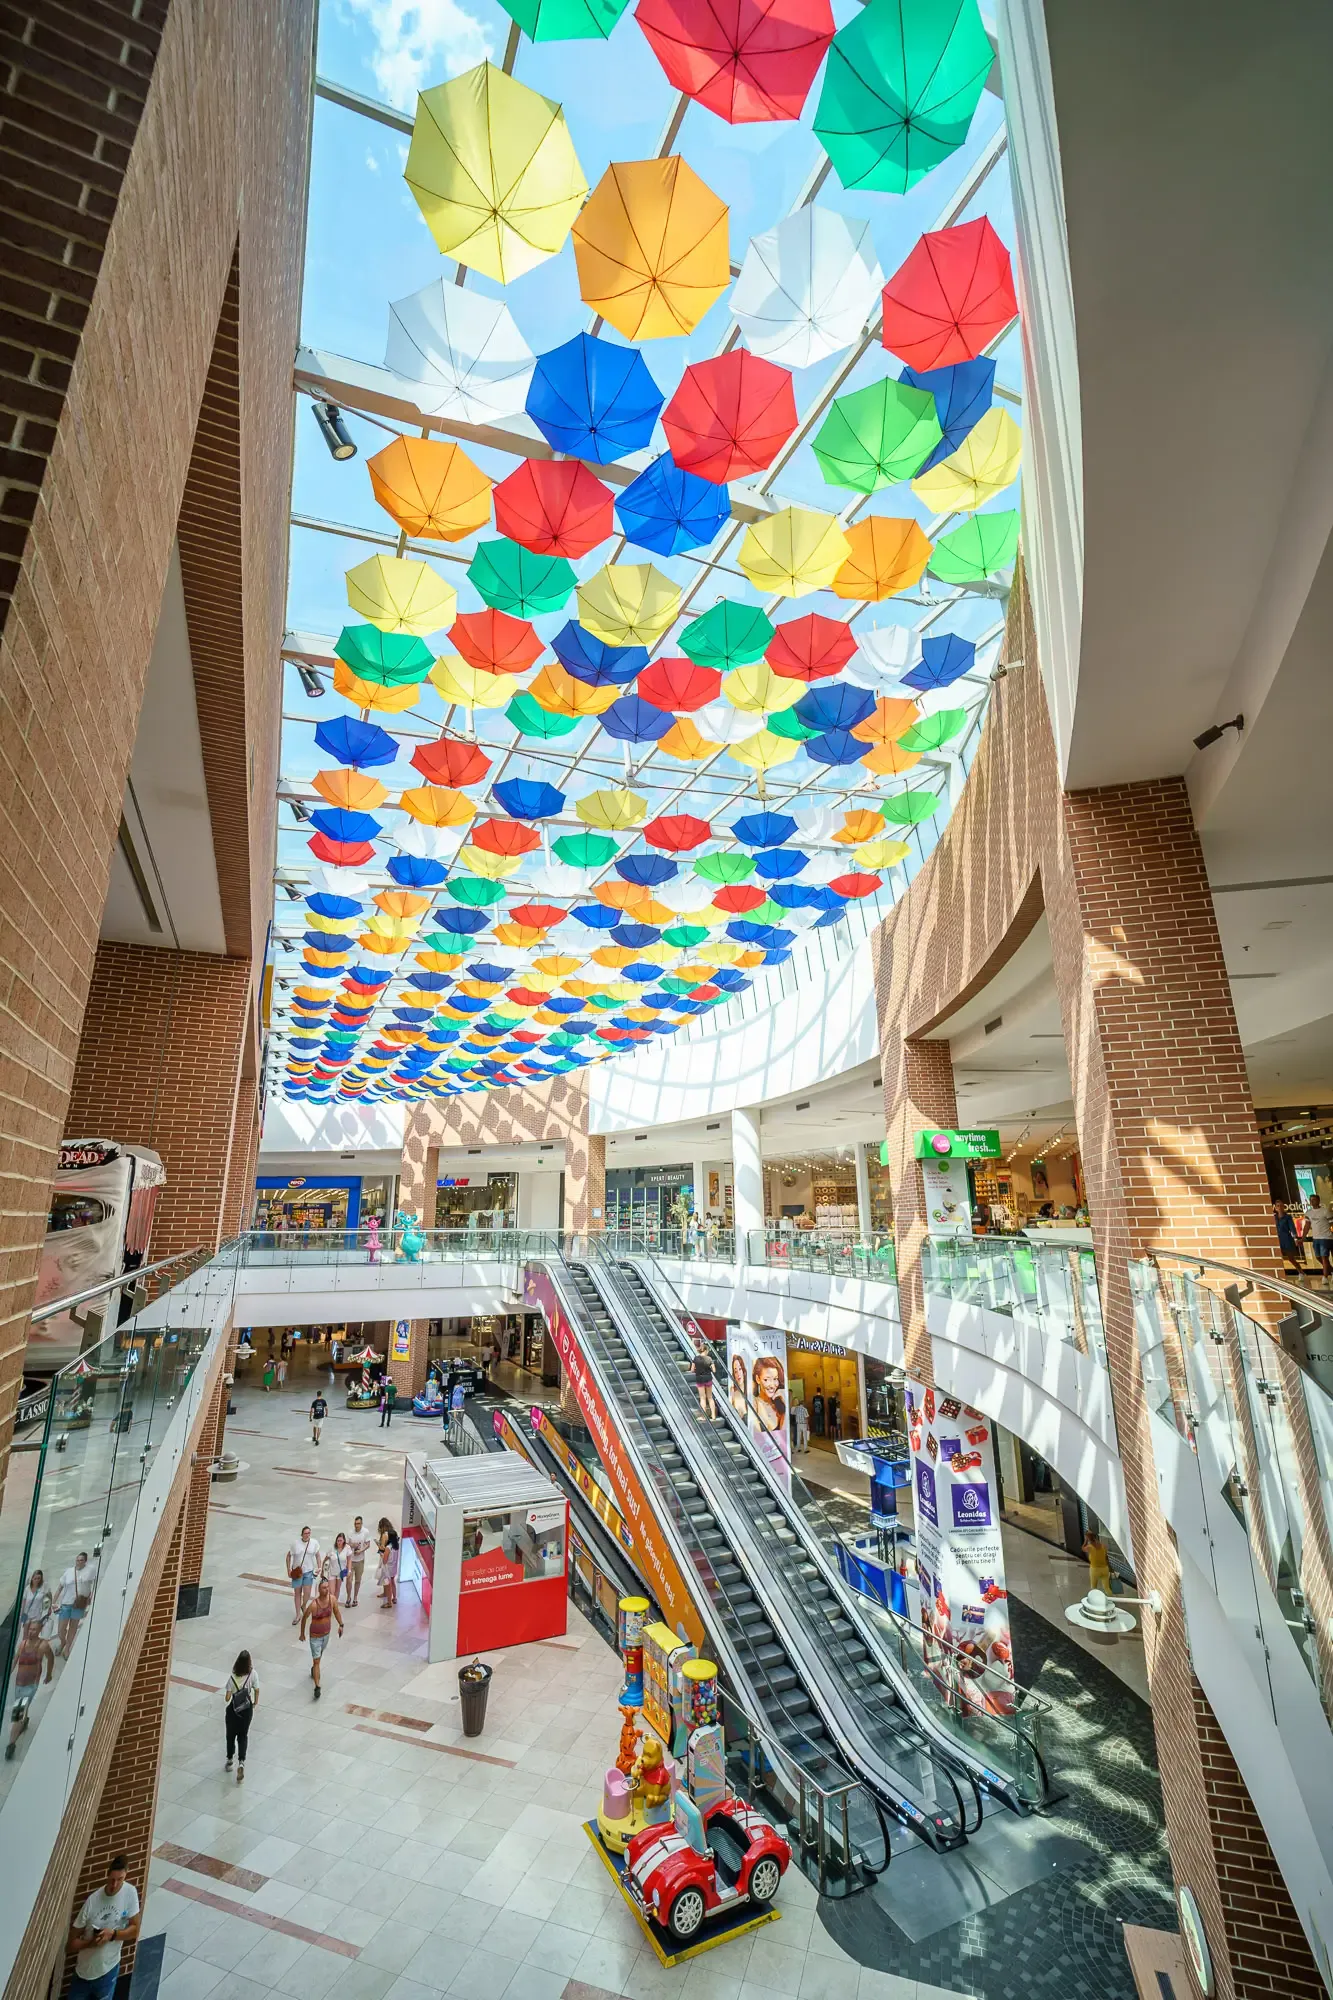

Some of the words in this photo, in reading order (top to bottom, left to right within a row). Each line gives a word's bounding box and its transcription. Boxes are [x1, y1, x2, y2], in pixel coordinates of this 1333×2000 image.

[954, 1133, 986, 1144] anytime
[57, 1150, 99, 1164] DEAD
[753, 1340, 782, 1352] STIL
[957, 1510, 987, 1518] Leonidas
[498, 1572, 514, 1580] lume
